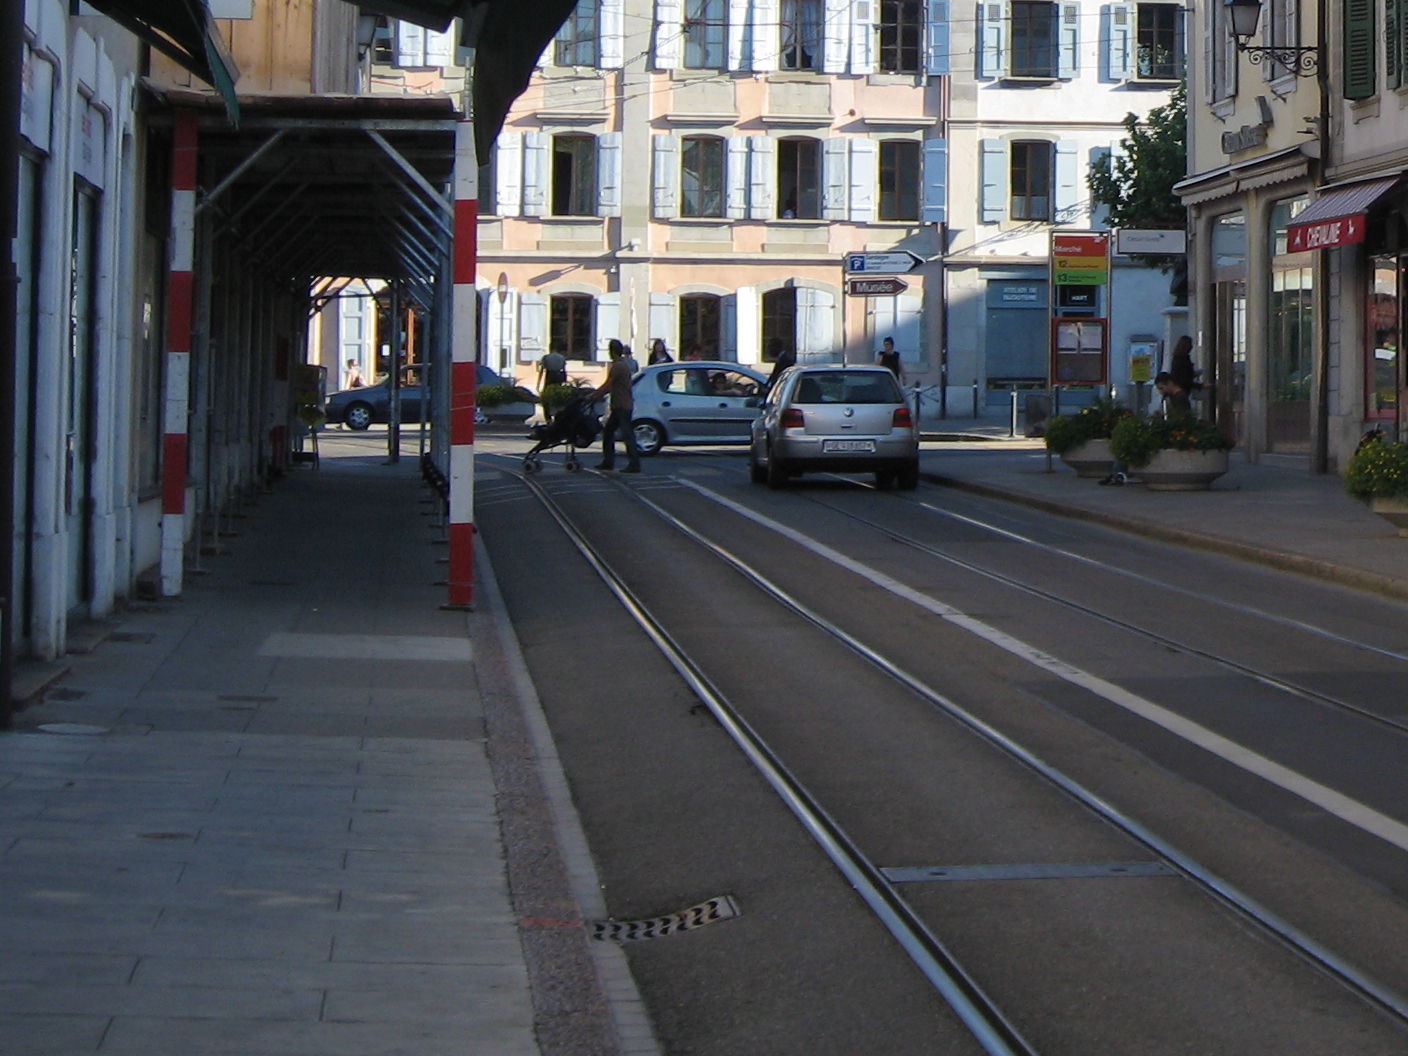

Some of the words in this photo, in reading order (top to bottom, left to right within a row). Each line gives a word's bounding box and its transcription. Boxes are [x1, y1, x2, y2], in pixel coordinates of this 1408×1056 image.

[1306, 222, 1342, 248] CHEVALINE
[1058, 273, 1068, 283] 13
[856, 281, 893, 292] Musée
